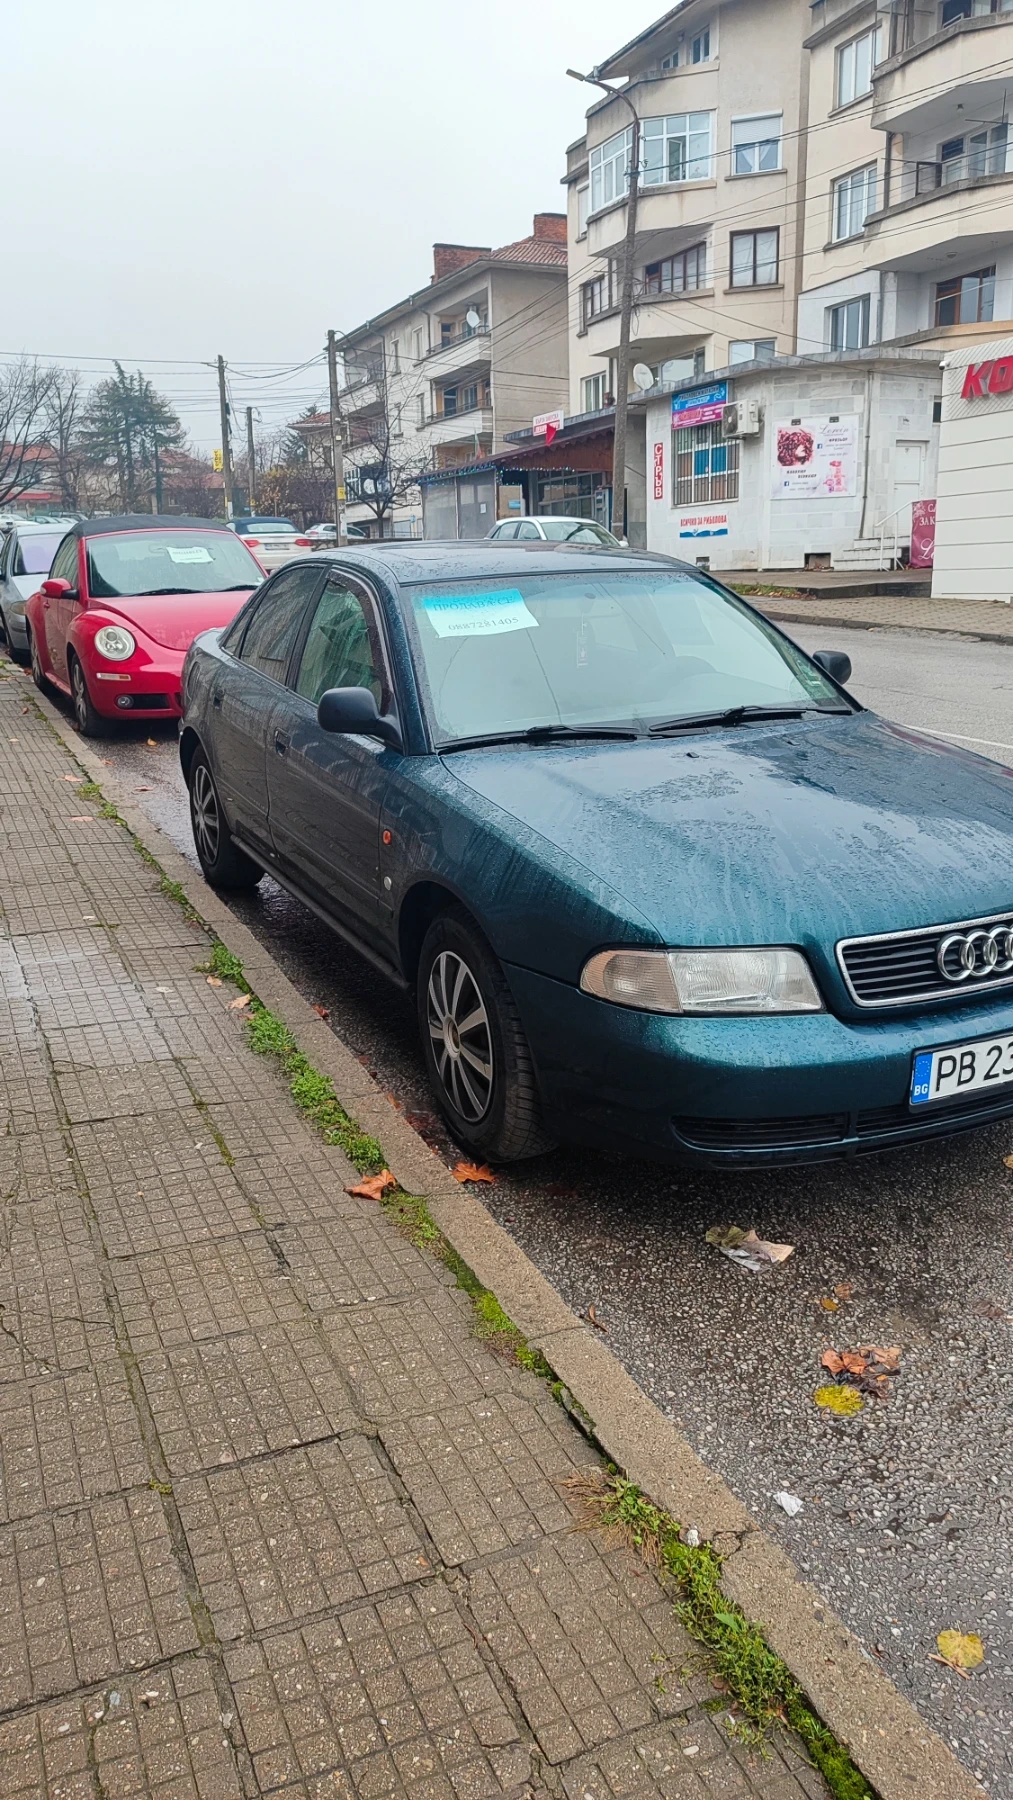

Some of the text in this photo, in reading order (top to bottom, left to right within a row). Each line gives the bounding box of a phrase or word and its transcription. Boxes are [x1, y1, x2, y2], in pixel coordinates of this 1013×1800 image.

[654, 444, 662, 498] СТРЪВ
[697, 516, 703, 526] ЗА
[919, 516, 929, 526] ЗА
[935, 1050, 976, 1092] PB
[914, 1083, 928, 1096] BG
